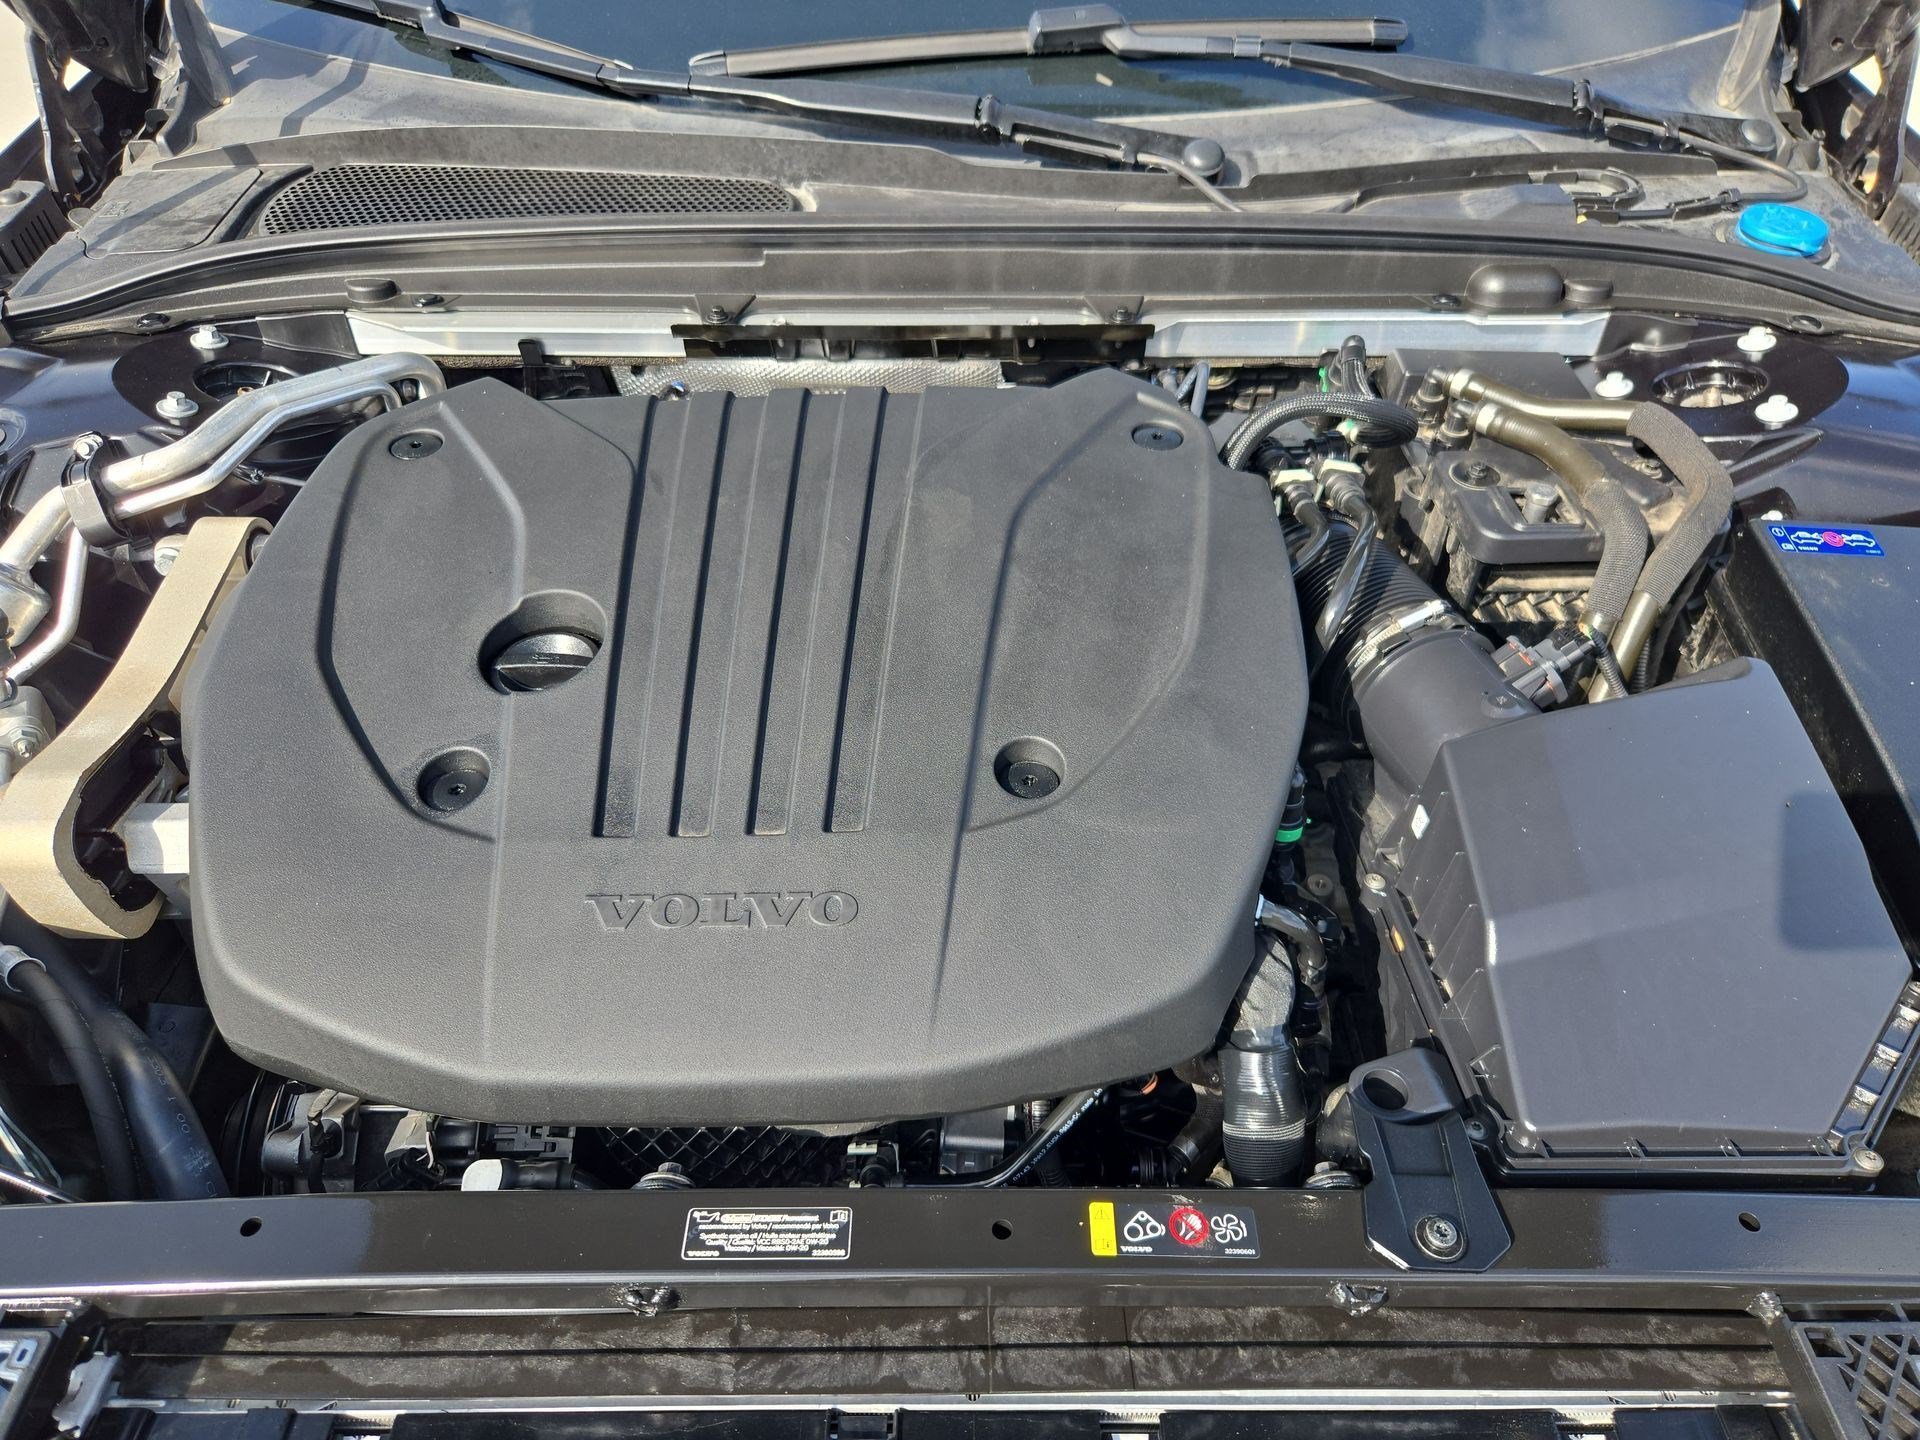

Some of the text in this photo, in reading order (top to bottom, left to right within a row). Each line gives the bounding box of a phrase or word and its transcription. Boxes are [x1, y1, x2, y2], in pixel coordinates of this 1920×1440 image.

[585, 891, 859, 931] VOLVO
[742, 1223, 751, 1231] by
[751, 1222, 768, 1230] Volvo
[822, 1222, 840, 1230] Volvo
[699, 1232, 729, 1240] Synthetic
[728, 1232, 750, 1240] engine
[1120, 1245, 1153, 1253] VOLVO
